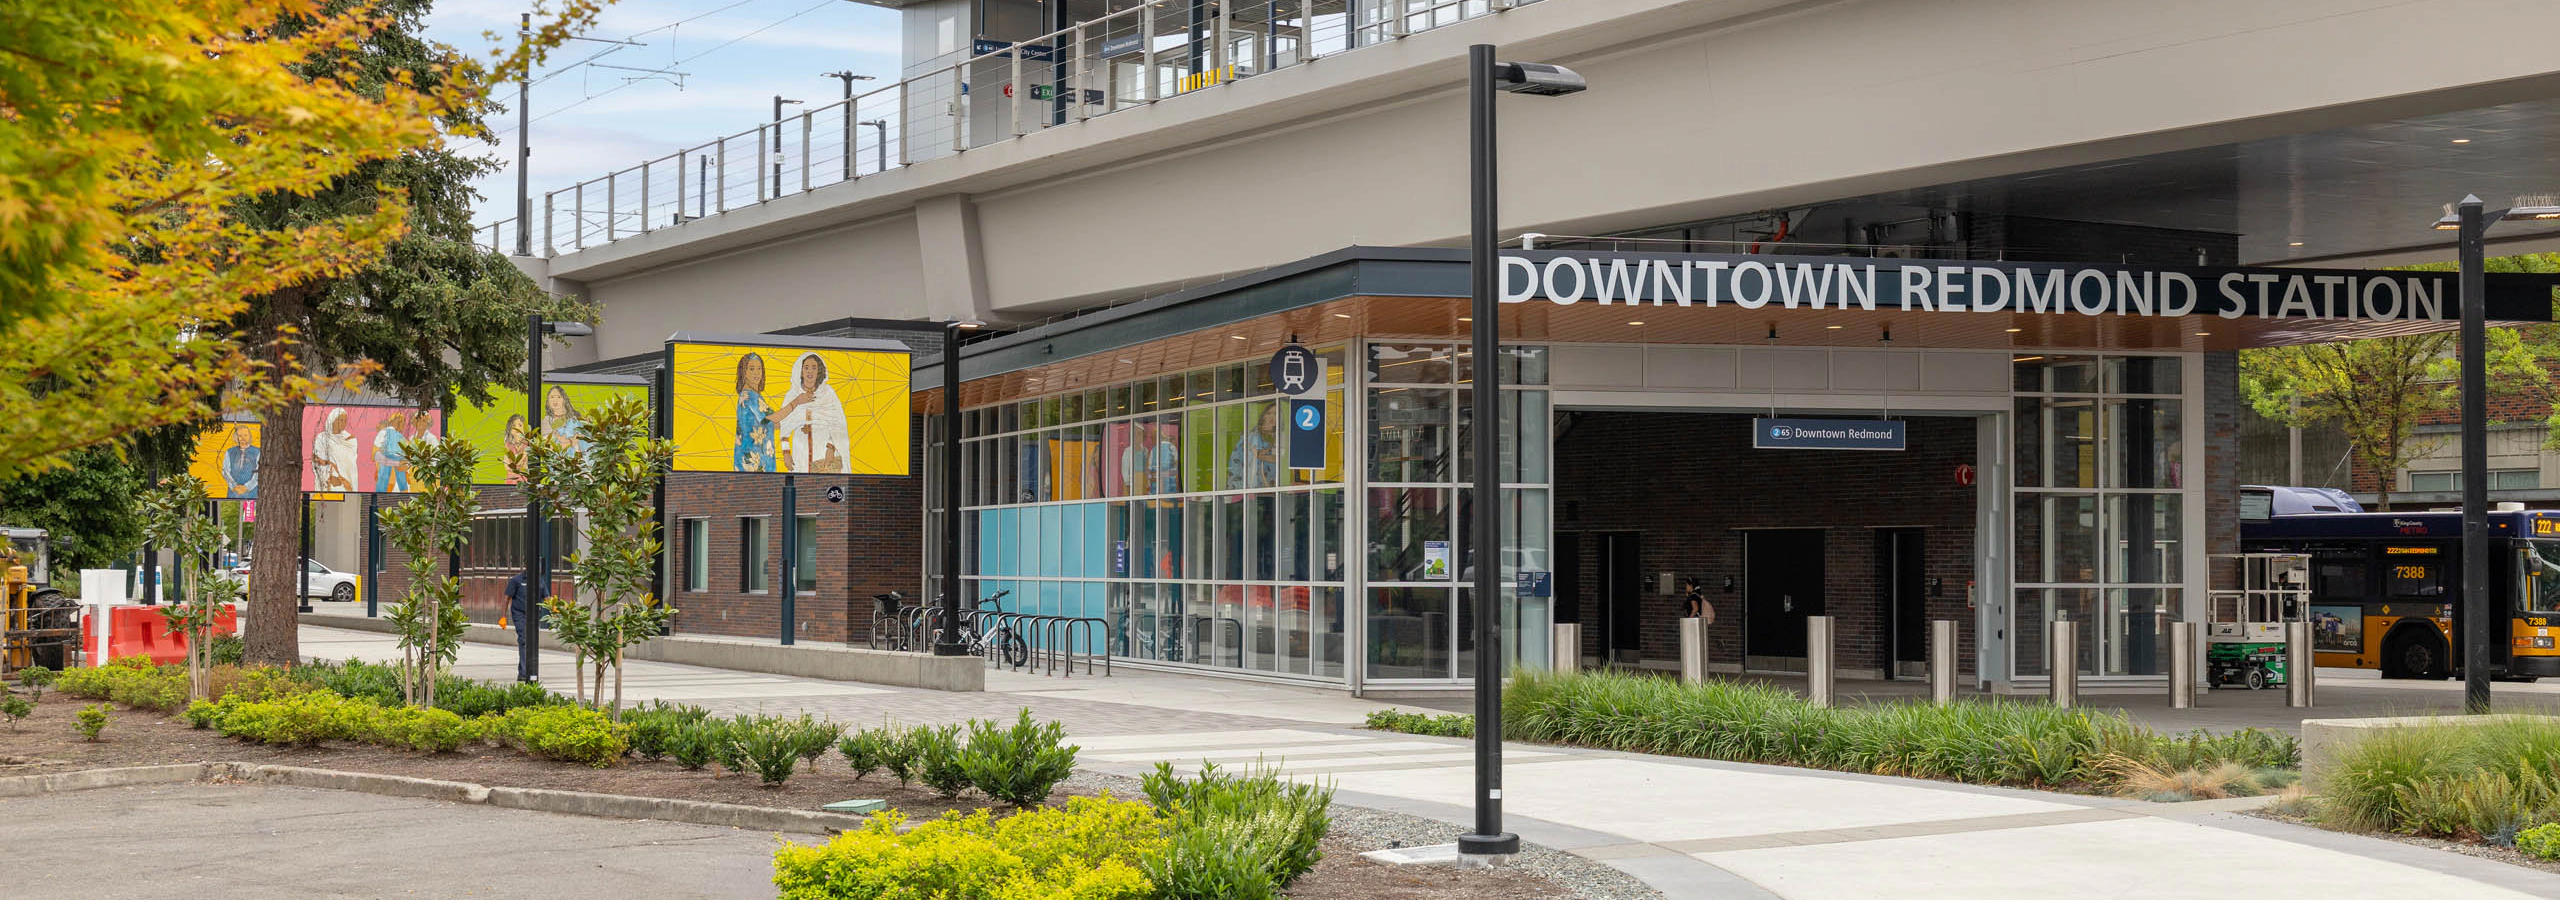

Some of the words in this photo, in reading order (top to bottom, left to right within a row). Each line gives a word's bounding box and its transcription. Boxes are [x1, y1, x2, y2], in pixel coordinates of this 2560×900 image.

[1042, 89, 1053, 97] EXI
[708, 157, 715, 166] 4
[1498, 256, 1876, 311] DOWNTOWN
[1901, 265, 2198, 317] REDMOND
[2218, 273, 2443, 322] STATION
[1302, 408, 1314, 427] 2
[1781, 429, 1790, 437] 65
[1795, 428, 1845, 439] Downtown
[1848, 428, 1893, 439] Redmond
[2537, 519, 2552, 534] 222
[2396, 566, 2425, 579] 7388
[2528, 617, 2547, 626] 7388
